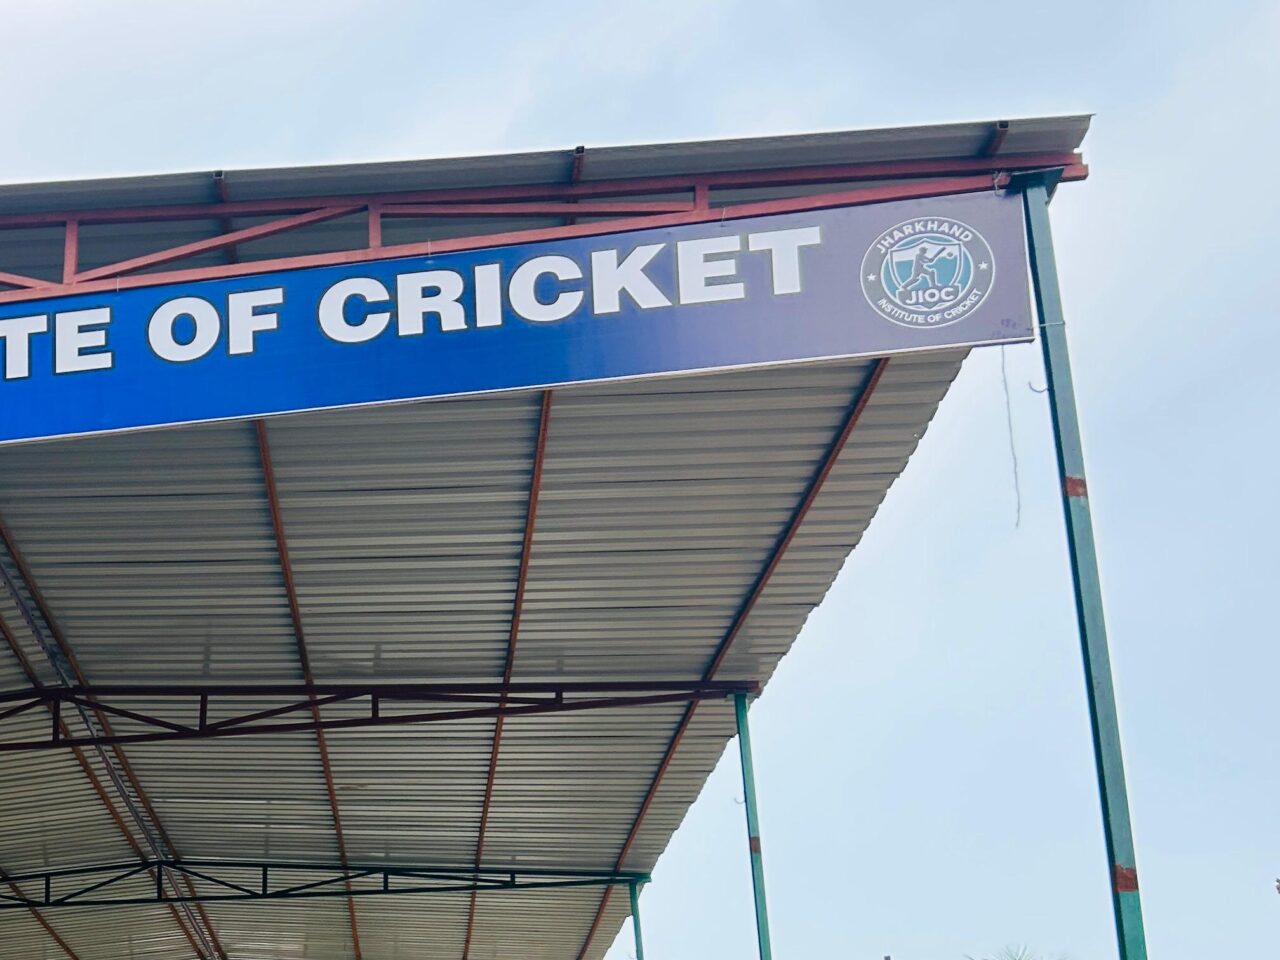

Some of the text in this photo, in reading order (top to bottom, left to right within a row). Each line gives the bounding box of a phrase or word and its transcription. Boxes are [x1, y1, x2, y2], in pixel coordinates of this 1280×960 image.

[876, 221, 973, 254] JHARKHAND
[148, 287, 284, 363] OF
[318, 226, 821, 344] CRICKET
[878, 288, 982, 323] INSTITUTE OF CRICKET
[906, 287, 955, 305] JIOC
